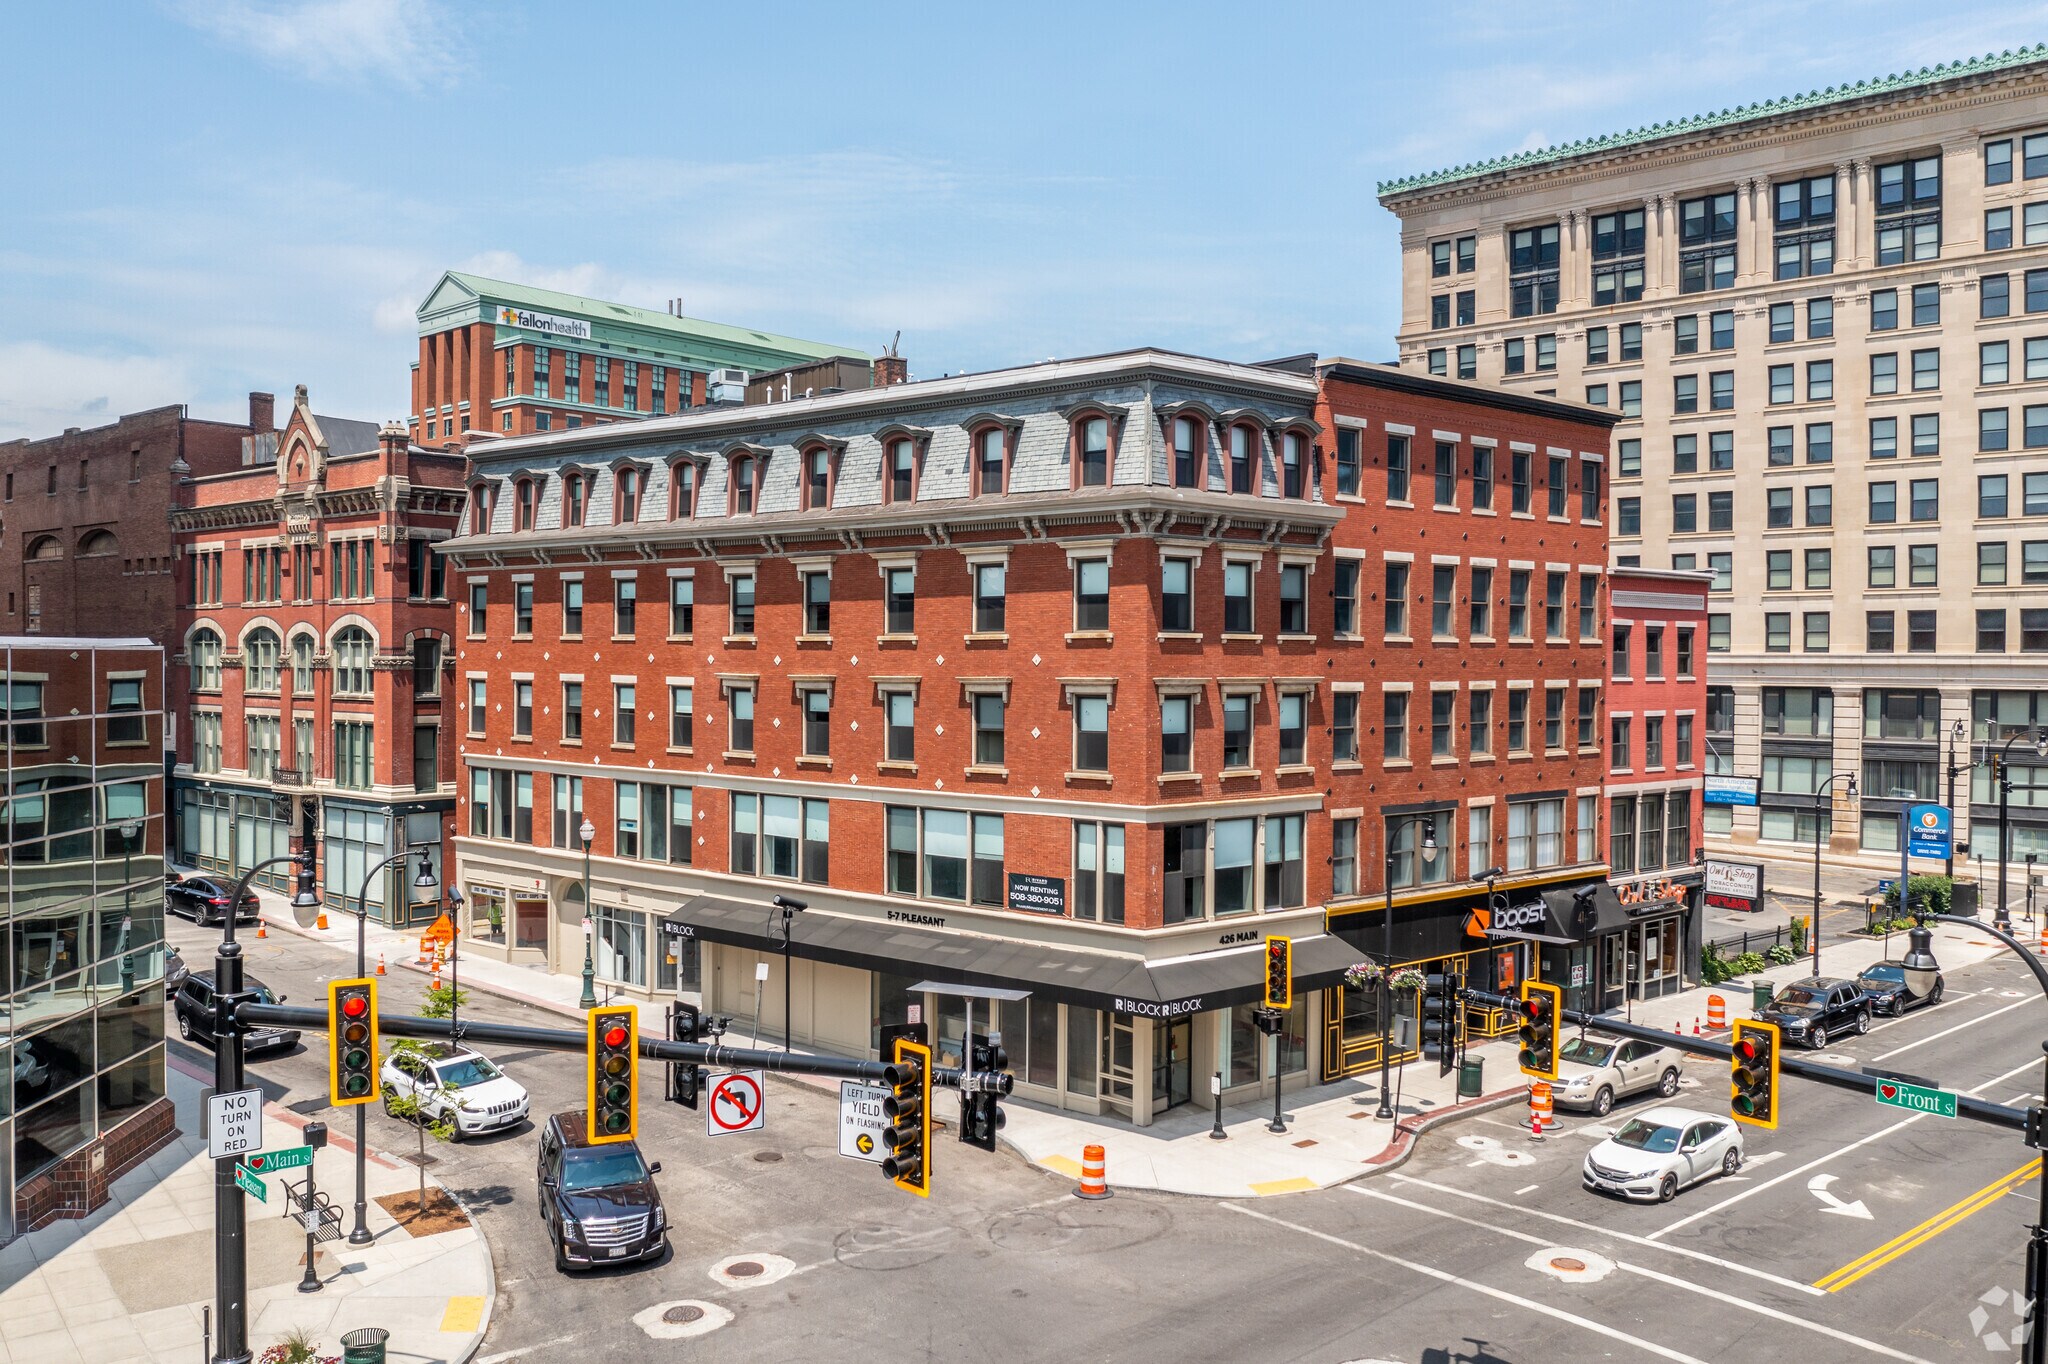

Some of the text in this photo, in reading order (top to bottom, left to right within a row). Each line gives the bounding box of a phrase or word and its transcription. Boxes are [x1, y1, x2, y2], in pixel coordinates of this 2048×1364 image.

[518, 311, 586, 337] fallonhealth
[1913, 825, 1947, 834] Commerce
[1709, 864, 1755, 882] Owl Shop
[1014, 884, 1059, 895] NOW RENTING
[1711, 880, 1754, 889] TOBACCONISTS
[1010, 892, 1063, 906] 508-380-9051
[887, 910, 945, 927] 5-7 PLEASANT
[1494, 899, 1547, 929] boost
[1219, 930, 1258, 944] 426 MAIN
[847, 1087, 886, 1102] LEFT TURN
[1897, 1085, 1954, 1115] Front St
[224, 1096, 247, 1111] NO
[852, 1100, 880, 1117] YIELD
[220, 1110, 252, 1124] TURN
[846, 1115, 854, 1125] ON
[227, 1125, 245, 1137] ON
[224, 1138, 248, 1152] RED
[266, 1150, 311, 1169] Main St
[241, 1170, 262, 1198] Pleasant
